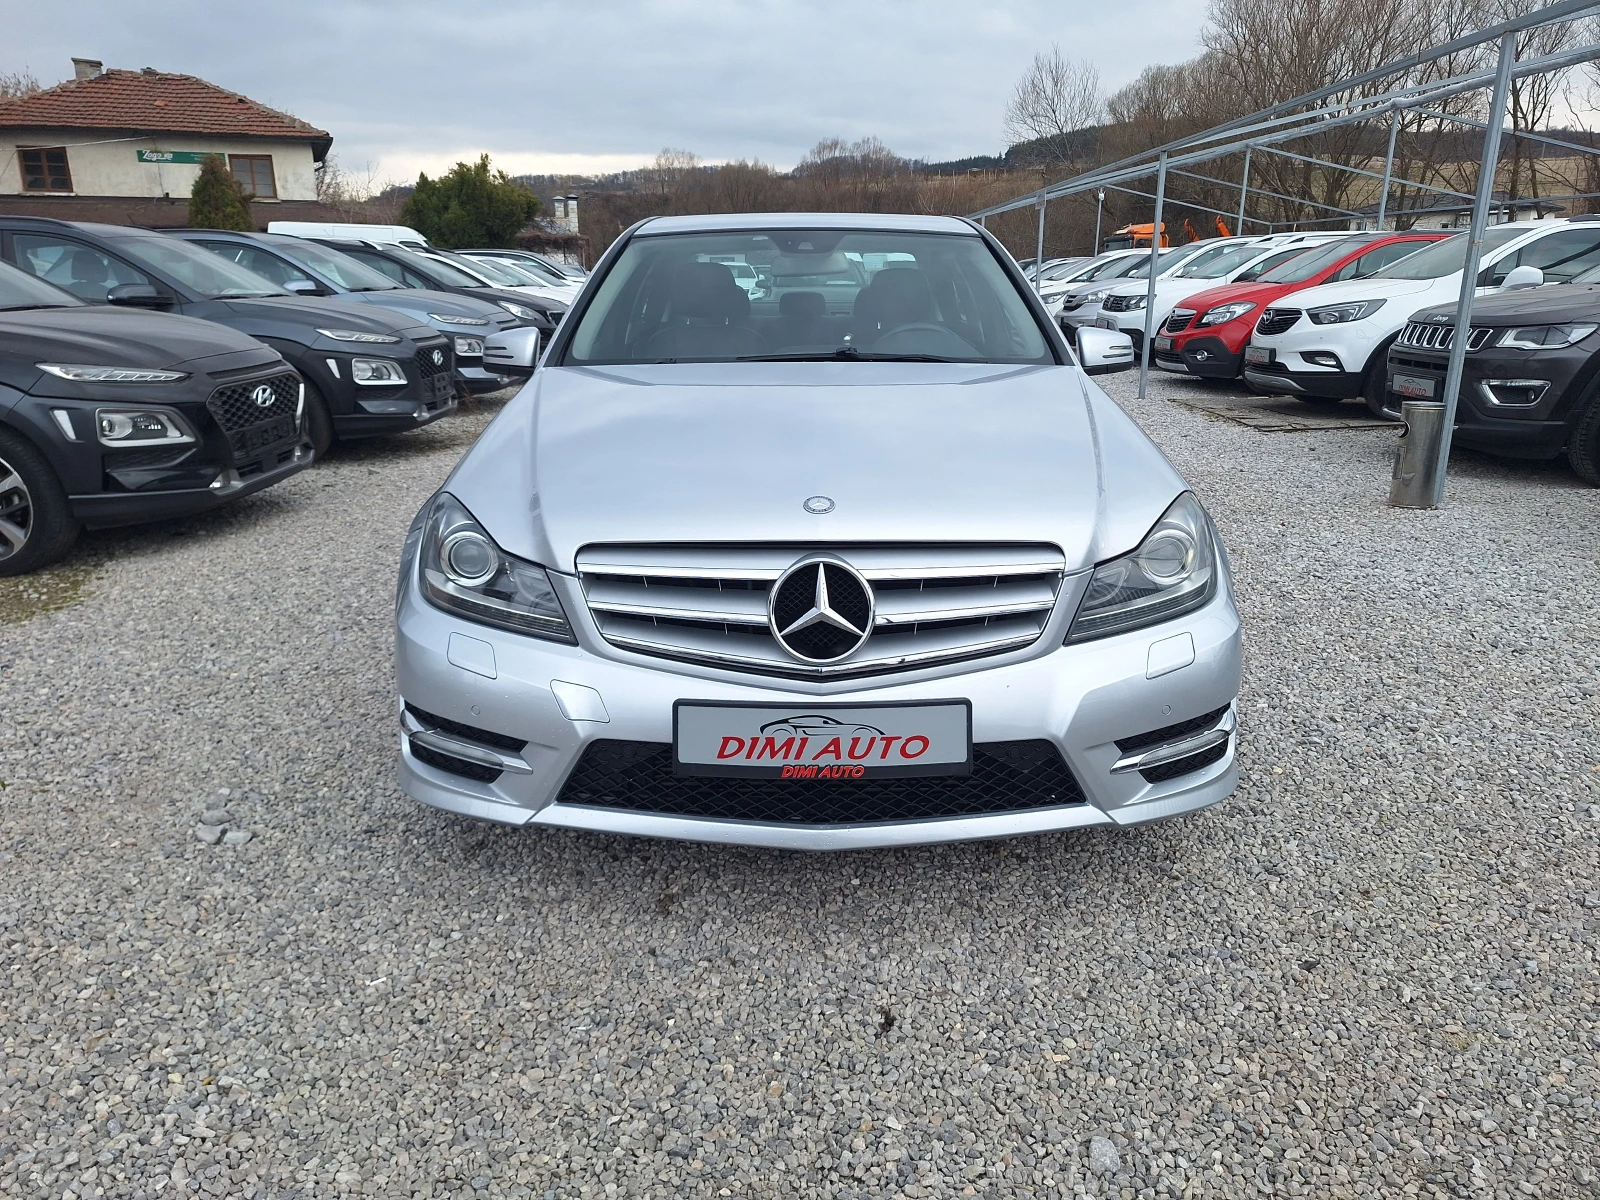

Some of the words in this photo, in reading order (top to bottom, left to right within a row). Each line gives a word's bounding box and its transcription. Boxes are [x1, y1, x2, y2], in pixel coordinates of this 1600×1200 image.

[142, 149, 173, 162] Zagoka
[717, 736, 808, 760] DIMI
[812, 735, 930, 760] AUTO
[781, 765, 818, 779] DIMI
[819, 765, 865, 779] AUTO
